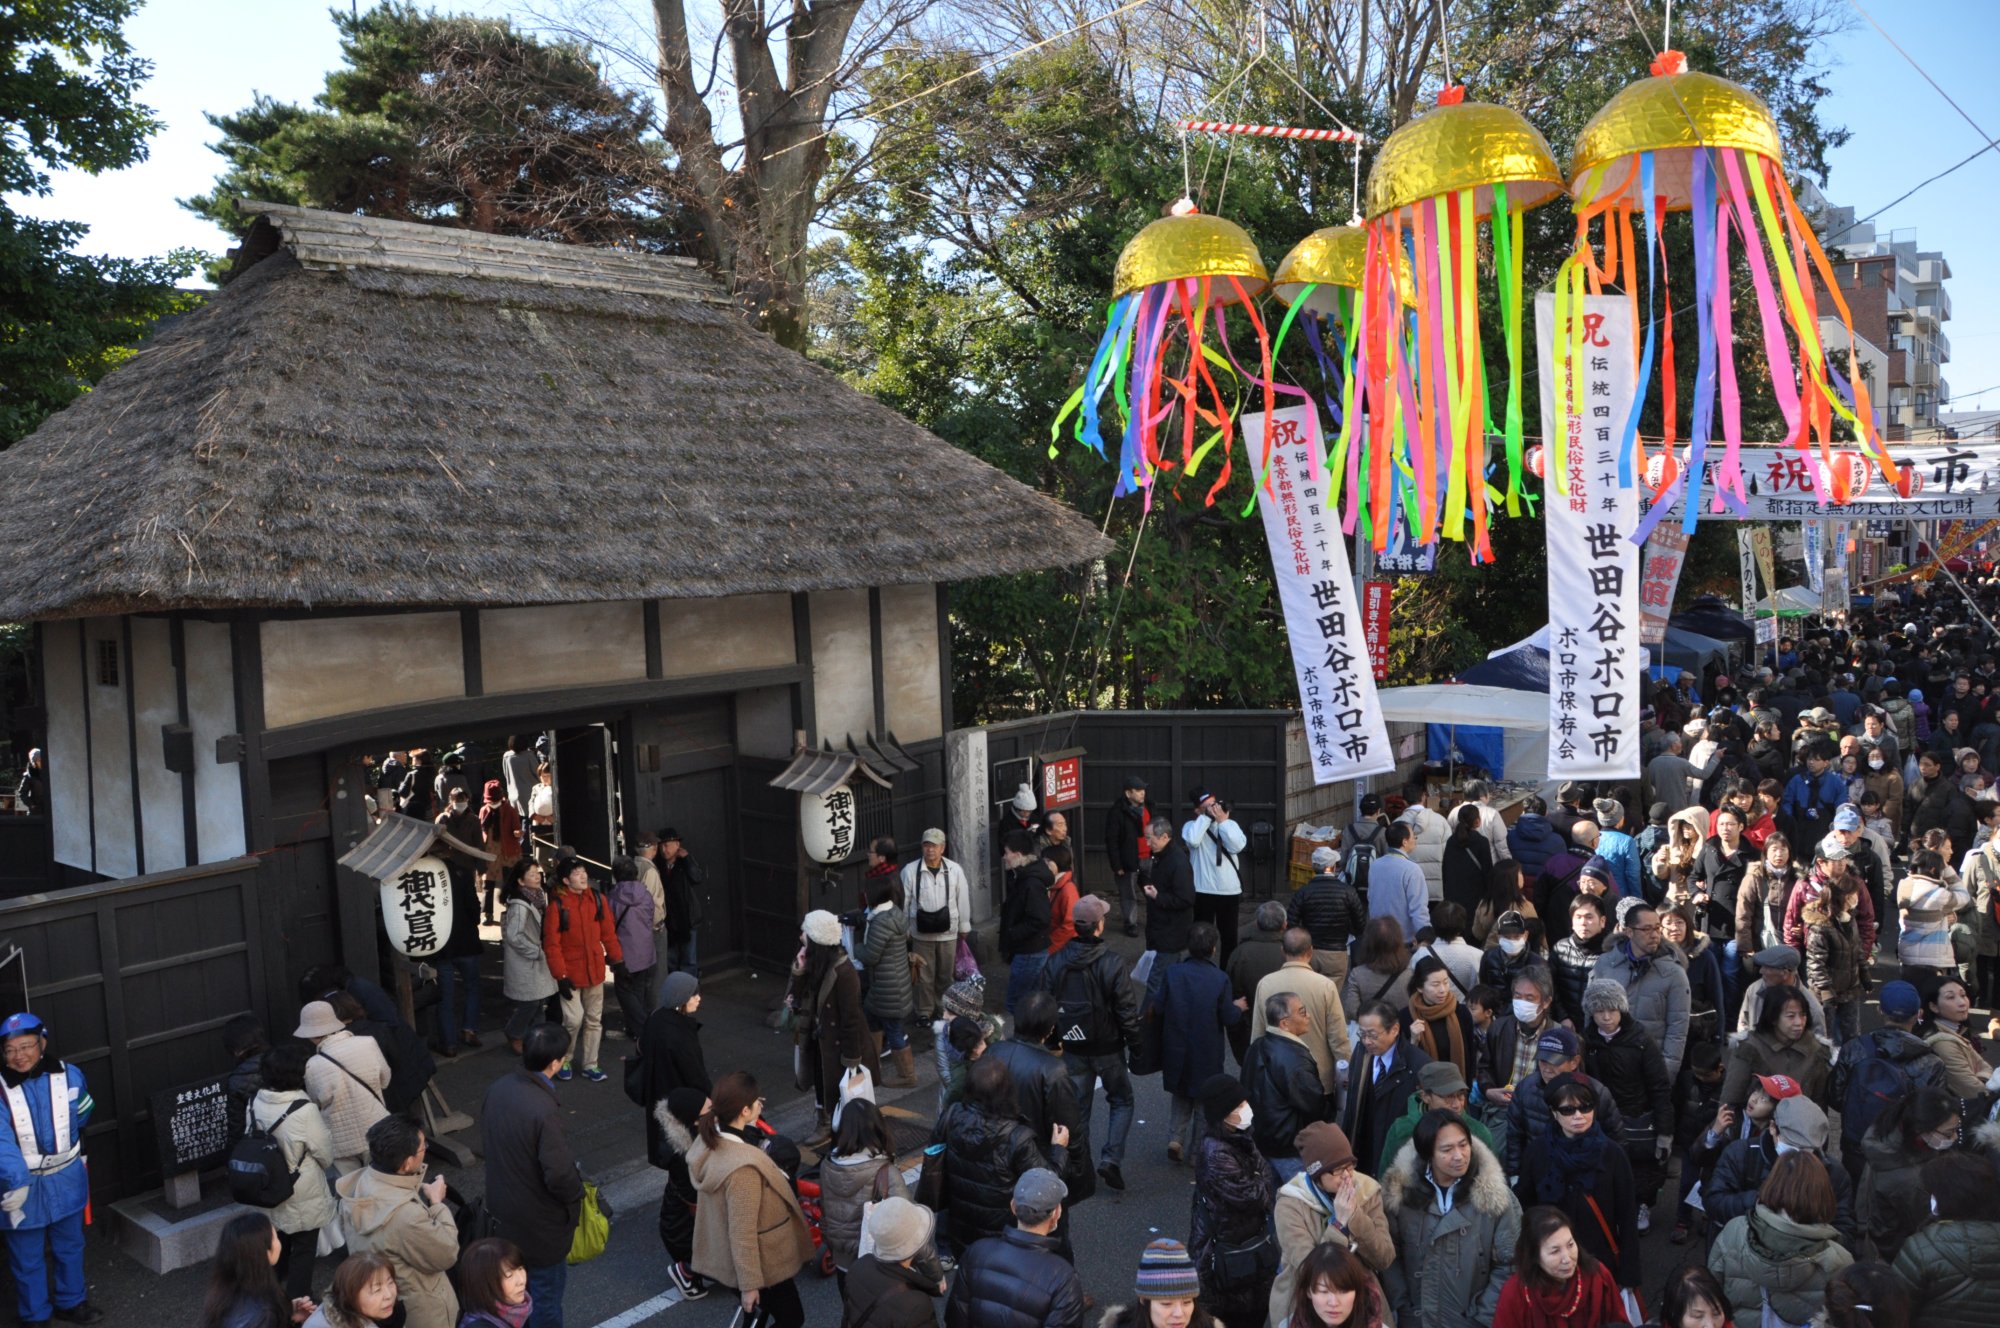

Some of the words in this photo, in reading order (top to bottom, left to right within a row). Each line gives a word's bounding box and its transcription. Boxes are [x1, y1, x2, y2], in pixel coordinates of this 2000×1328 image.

[1566, 313, 1611, 348] 祝
[1271, 419, 1307, 448] 祝
[1590, 356, 1619, 513] 伝統四百三十年
[1765, 451, 1814, 493] 祝
[1272, 454, 1311, 576] 東京都無形民俗文化財
[1294, 451, 1333, 572] 伝統四百三十年
[1765, 497, 1975, 516] 都指定無形民俗文化財
[1378, 553, 1433, 572] 桜栄会
[1742, 530, 1753, 601] くすのき
[1310, 580, 1371, 763] 世田谷ボロ市
[1367, 586, 1382, 677] 福引き大売り出
[1583, 523, 1626, 763] 世田谷ボロ市
[1303, 666, 1334, 767] ボロ市保存会
[1557, 627, 1580, 760] ボロ市保存会
[824, 791, 852, 860] 御代官所
[396, 869, 438, 953] 御代官所
[176, 1082, 221, 1105] 重要文化財
